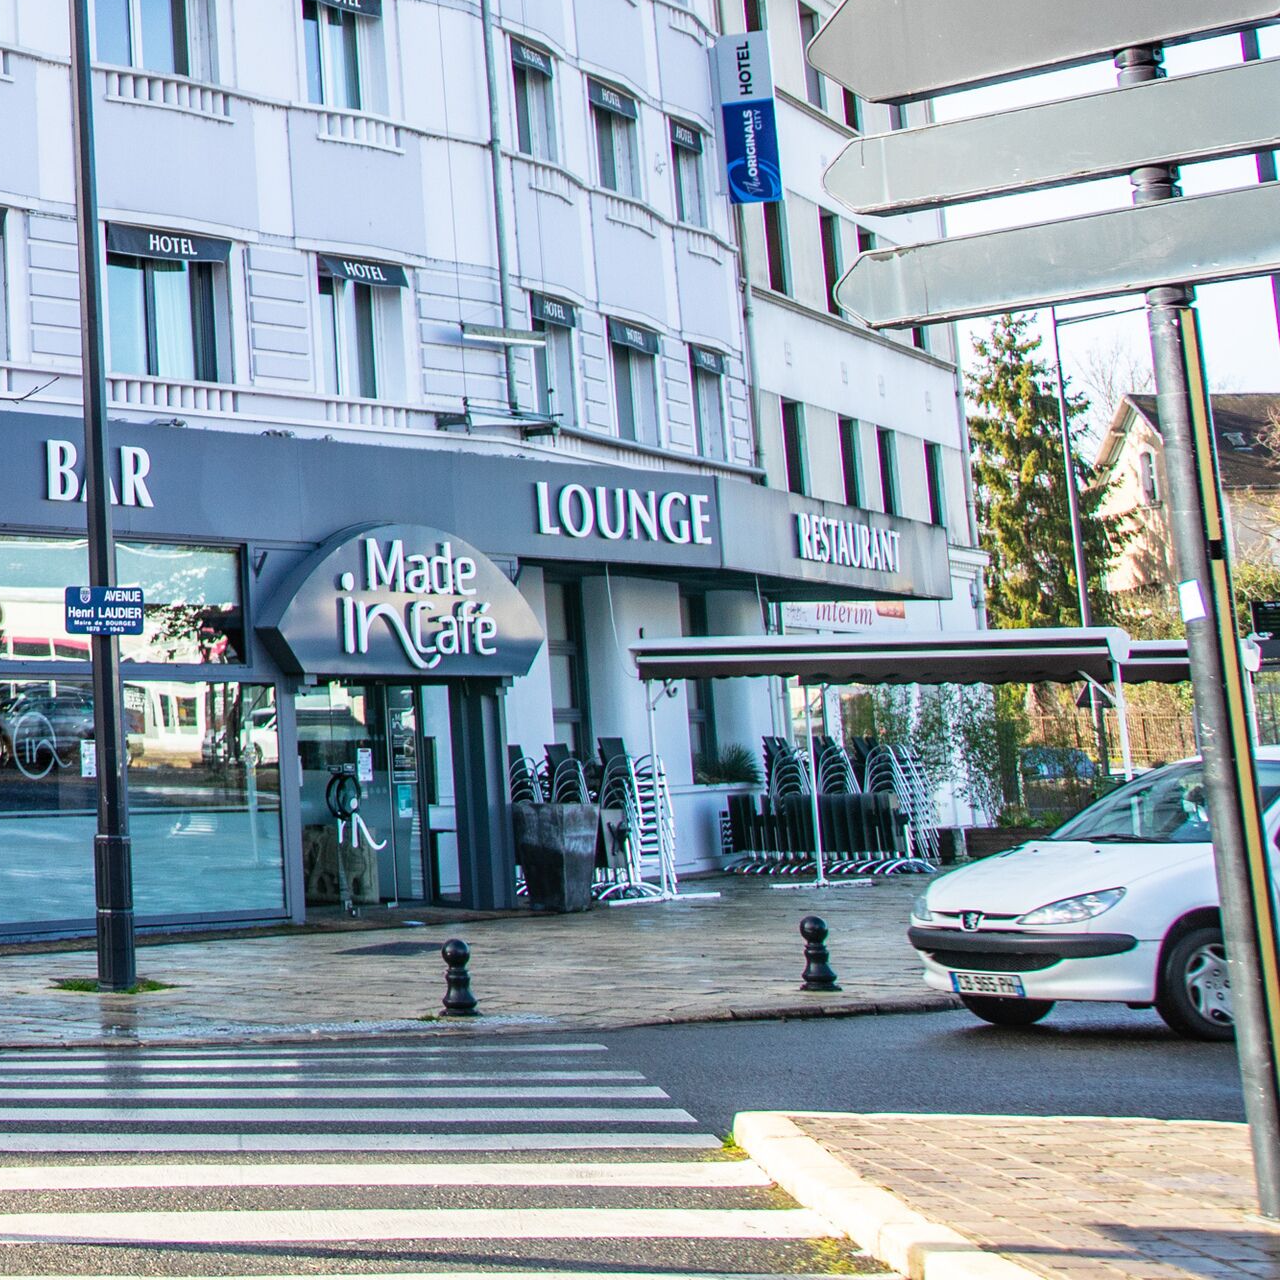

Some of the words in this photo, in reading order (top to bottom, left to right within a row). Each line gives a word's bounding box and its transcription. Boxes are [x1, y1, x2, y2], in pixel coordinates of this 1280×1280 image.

[736, 40, 754, 96] HOTEL
[743, 109, 758, 177] ORIGINALS
[753, 109, 763, 131] CITY
[149, 232, 197, 257] HOTEL
[343, 260, 387, 283] HOTEL
[536, 481, 712, 545] LOUNGE
[365, 538, 477, 596] Made
[797, 512, 901, 573] RESTAURANT
[68, 606, 94, 618] Henri
[98, 607, 142, 619] LAUDIER
[104, 590, 141, 602] AVENUE
[341, 572, 441, 670] in
[411, 600, 497, 656] Café
